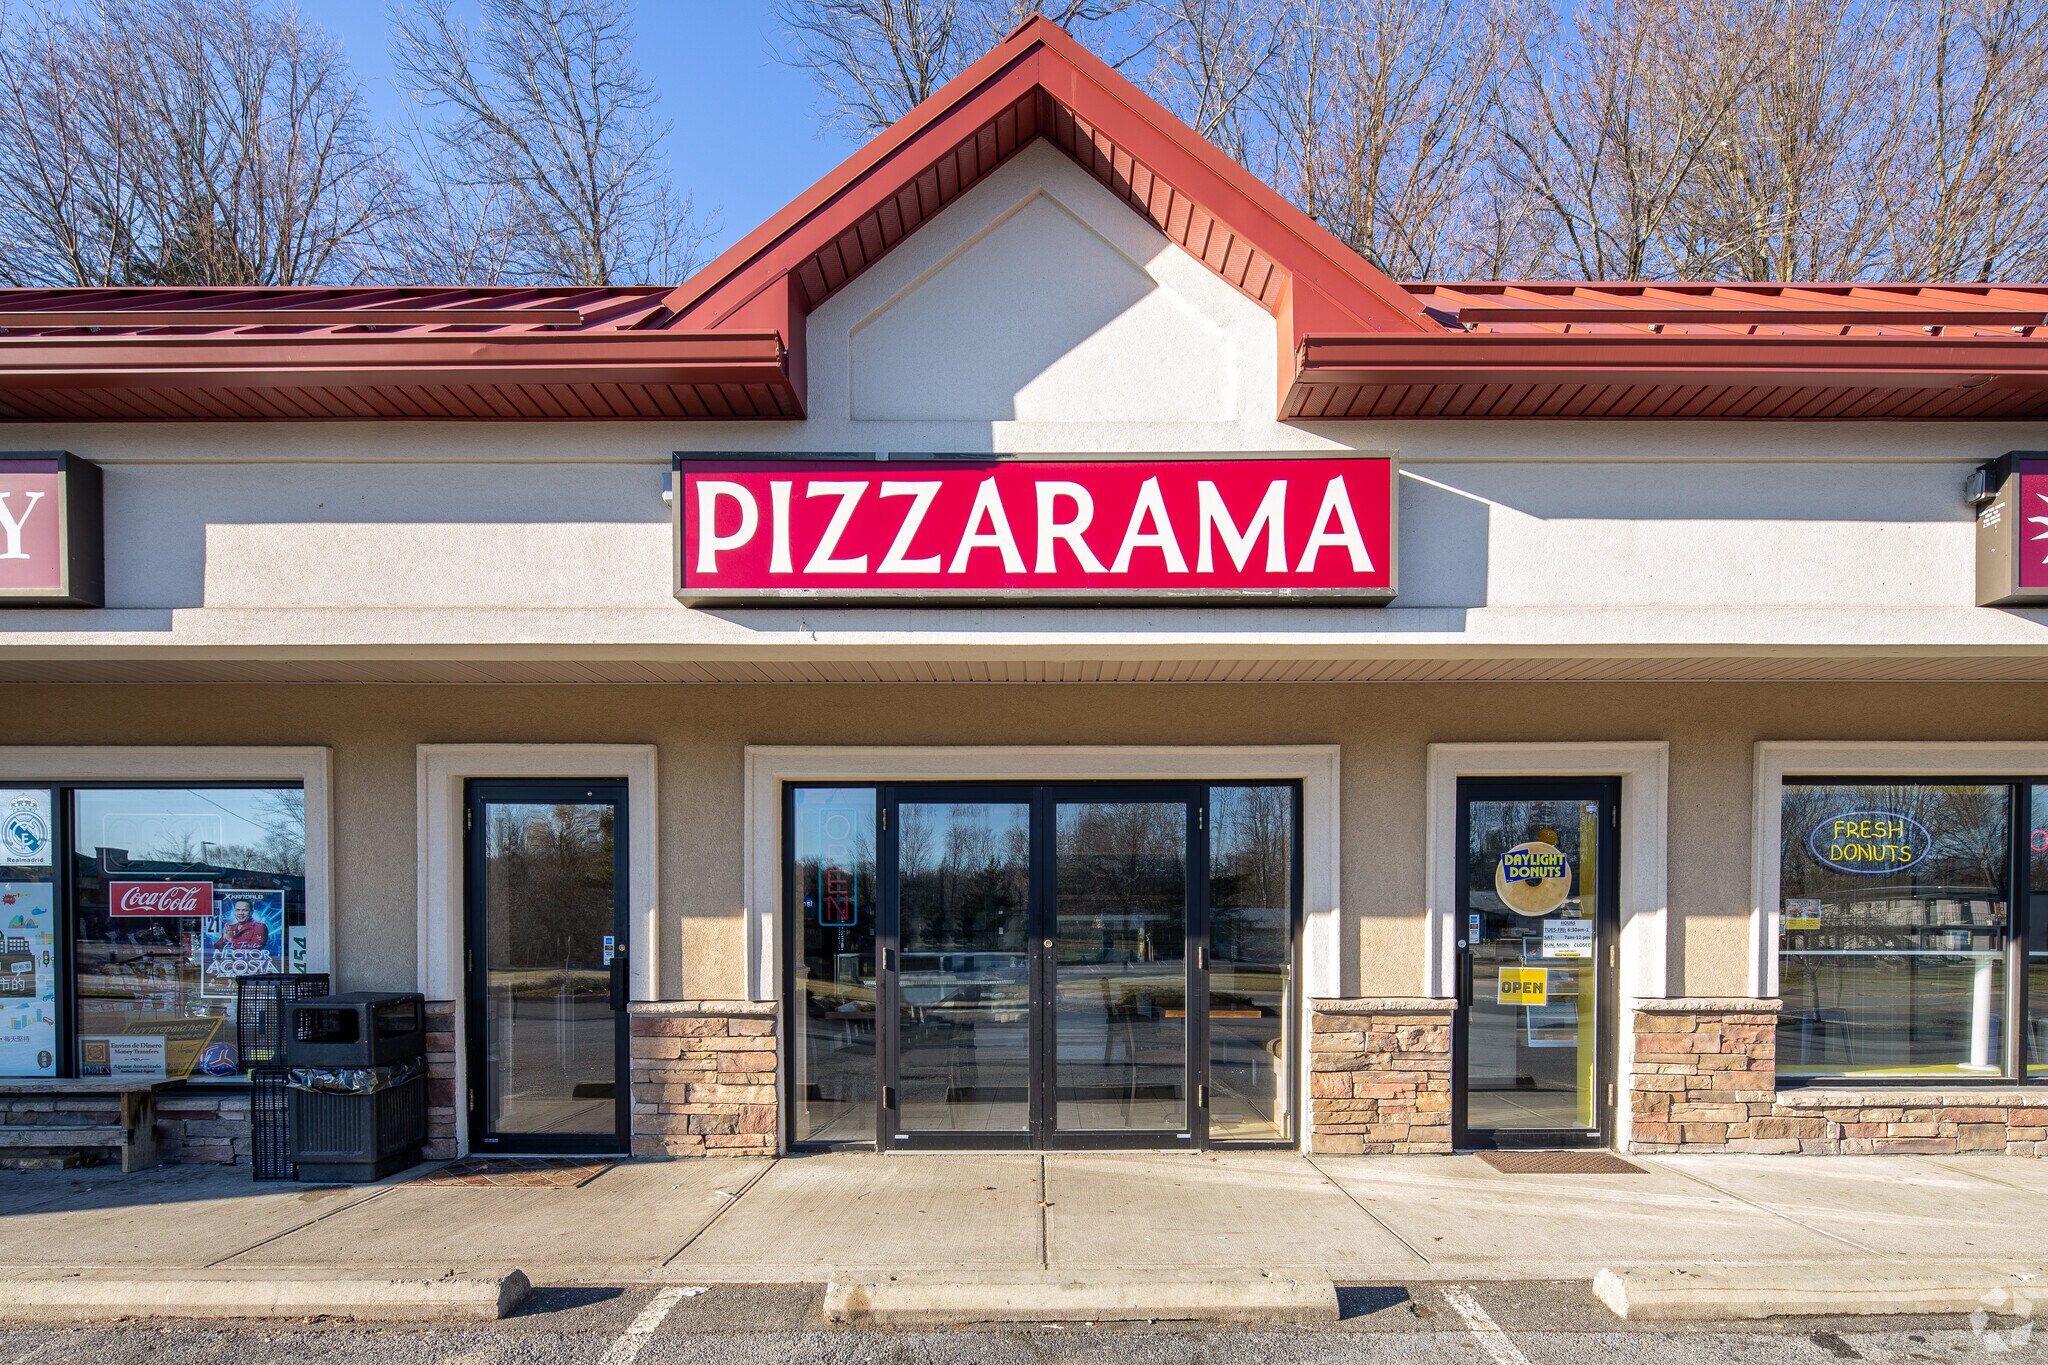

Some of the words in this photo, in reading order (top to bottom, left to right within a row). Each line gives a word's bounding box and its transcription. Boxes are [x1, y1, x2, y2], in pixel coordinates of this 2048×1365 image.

[0, 491, 45, 560] Y
[696, 474, 1376, 574] PIZZARAMA
[1833, 820, 1904, 839] FRESH
[1504, 853, 1566, 866] DAYLIGHT
[1830, 843, 1912, 862] DONUTS
[825, 814, 850, 921] OPEN
[1509, 866, 1561, 878] DONUTS
[120, 886, 201, 911] Coca-Cola
[207, 916, 220, 933] 21
[212, 948, 273, 961] HECTOR
[206, 960, 280, 974] ACOSTA
[1501, 981, 1544, 994] OPEN
[148, 1022, 188, 1035] prepaid
[188, 1021, 215, 1032] here!
